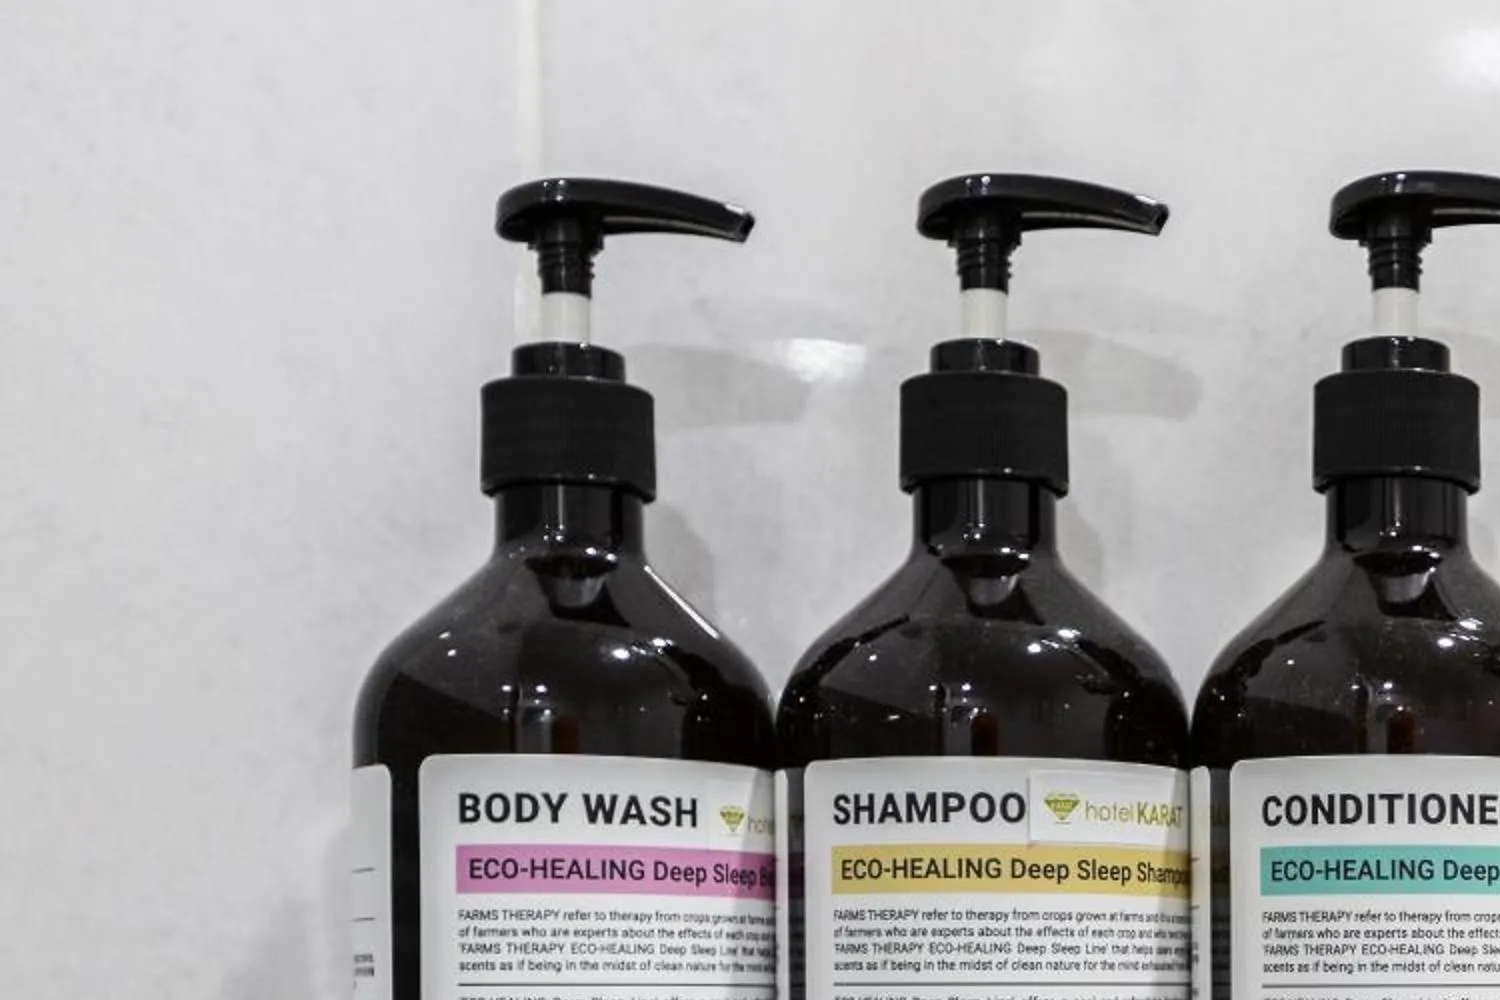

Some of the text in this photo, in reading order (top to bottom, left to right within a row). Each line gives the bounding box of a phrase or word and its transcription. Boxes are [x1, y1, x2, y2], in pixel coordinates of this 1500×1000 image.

[458, 792, 568, 823] BODY
[584, 794, 698, 827] WASH
[833, 792, 1026, 824] SHAMPOO
[469, 857, 645, 882] ECO-HEALING
[653, 861, 707, 886] Deep
[713, 863, 758, 888] Sleep
[841, 858, 1001, 880] ECO-HEALING
[1011, 859, 1069, 884] Deep
[1077, 861, 1131, 886] Sleep
[1271, 859, 1434, 882] ECO-HEALING
[1444, 860, 1499, 886] Deep
